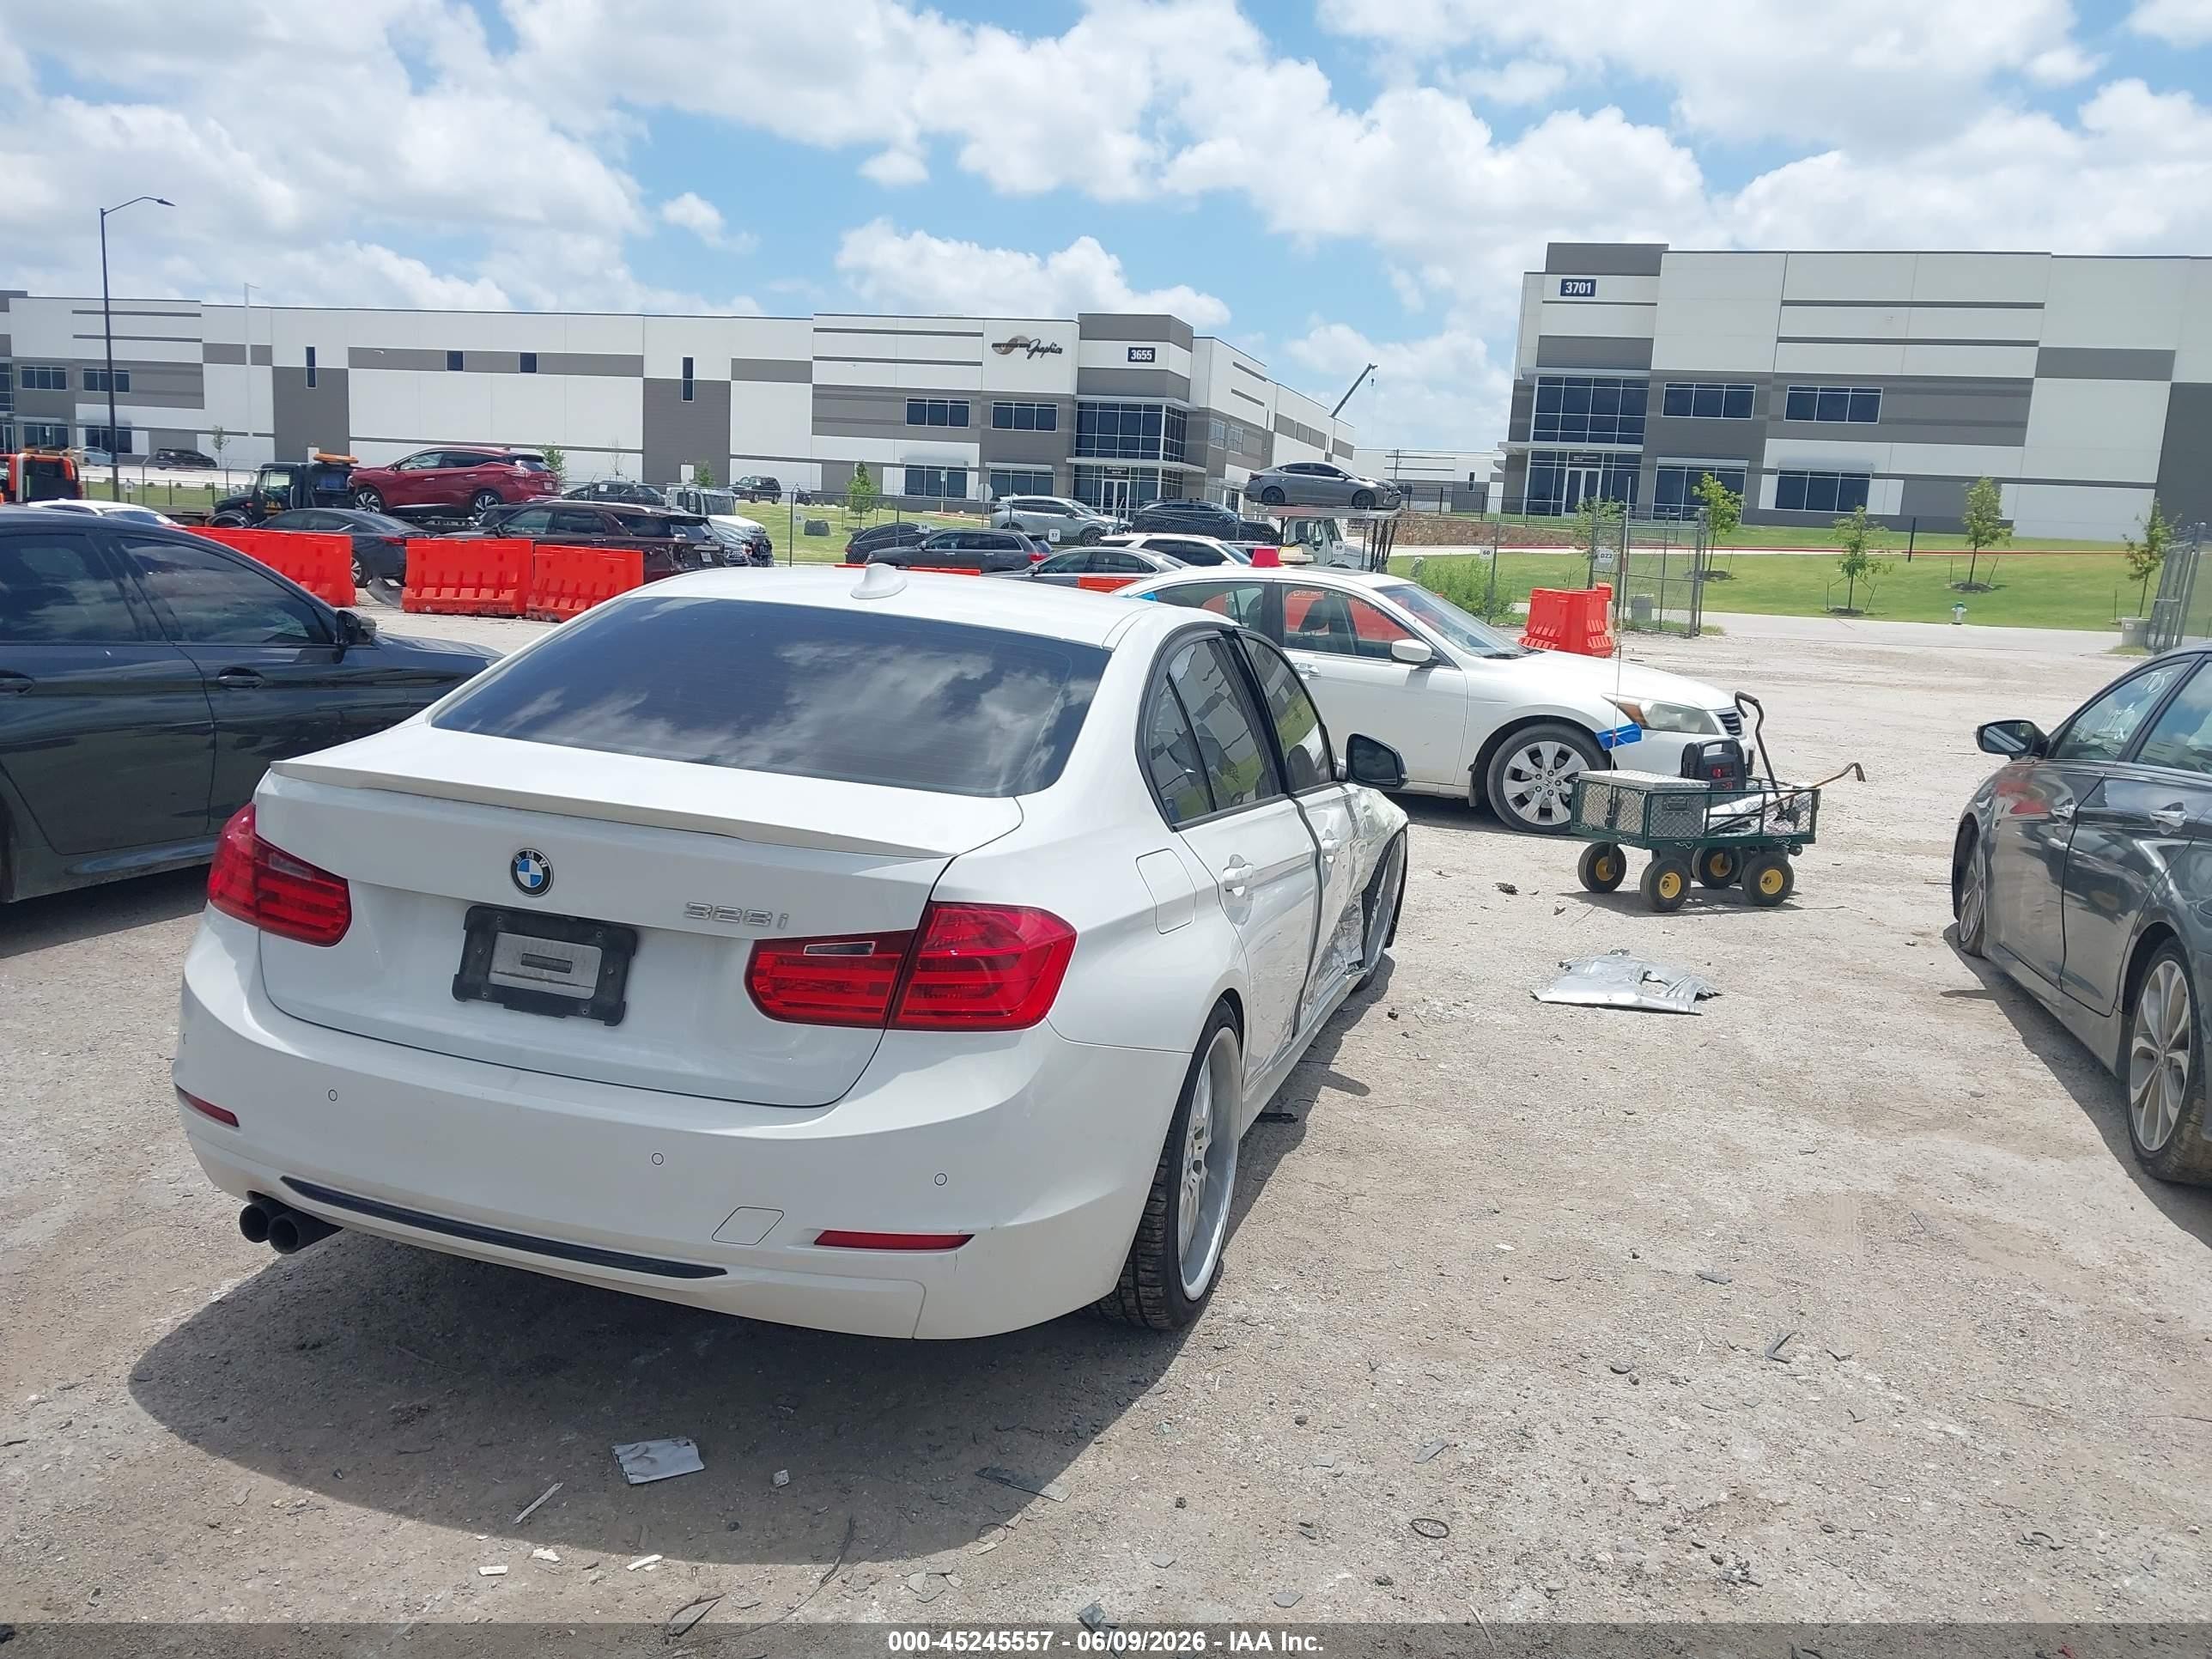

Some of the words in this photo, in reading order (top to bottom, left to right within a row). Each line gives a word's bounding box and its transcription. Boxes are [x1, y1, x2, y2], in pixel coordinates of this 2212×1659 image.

[1565, 281, 1591, 294] 3701
[1130, 349, 1152, 361] 3655
[684, 901, 790, 930] 328i
